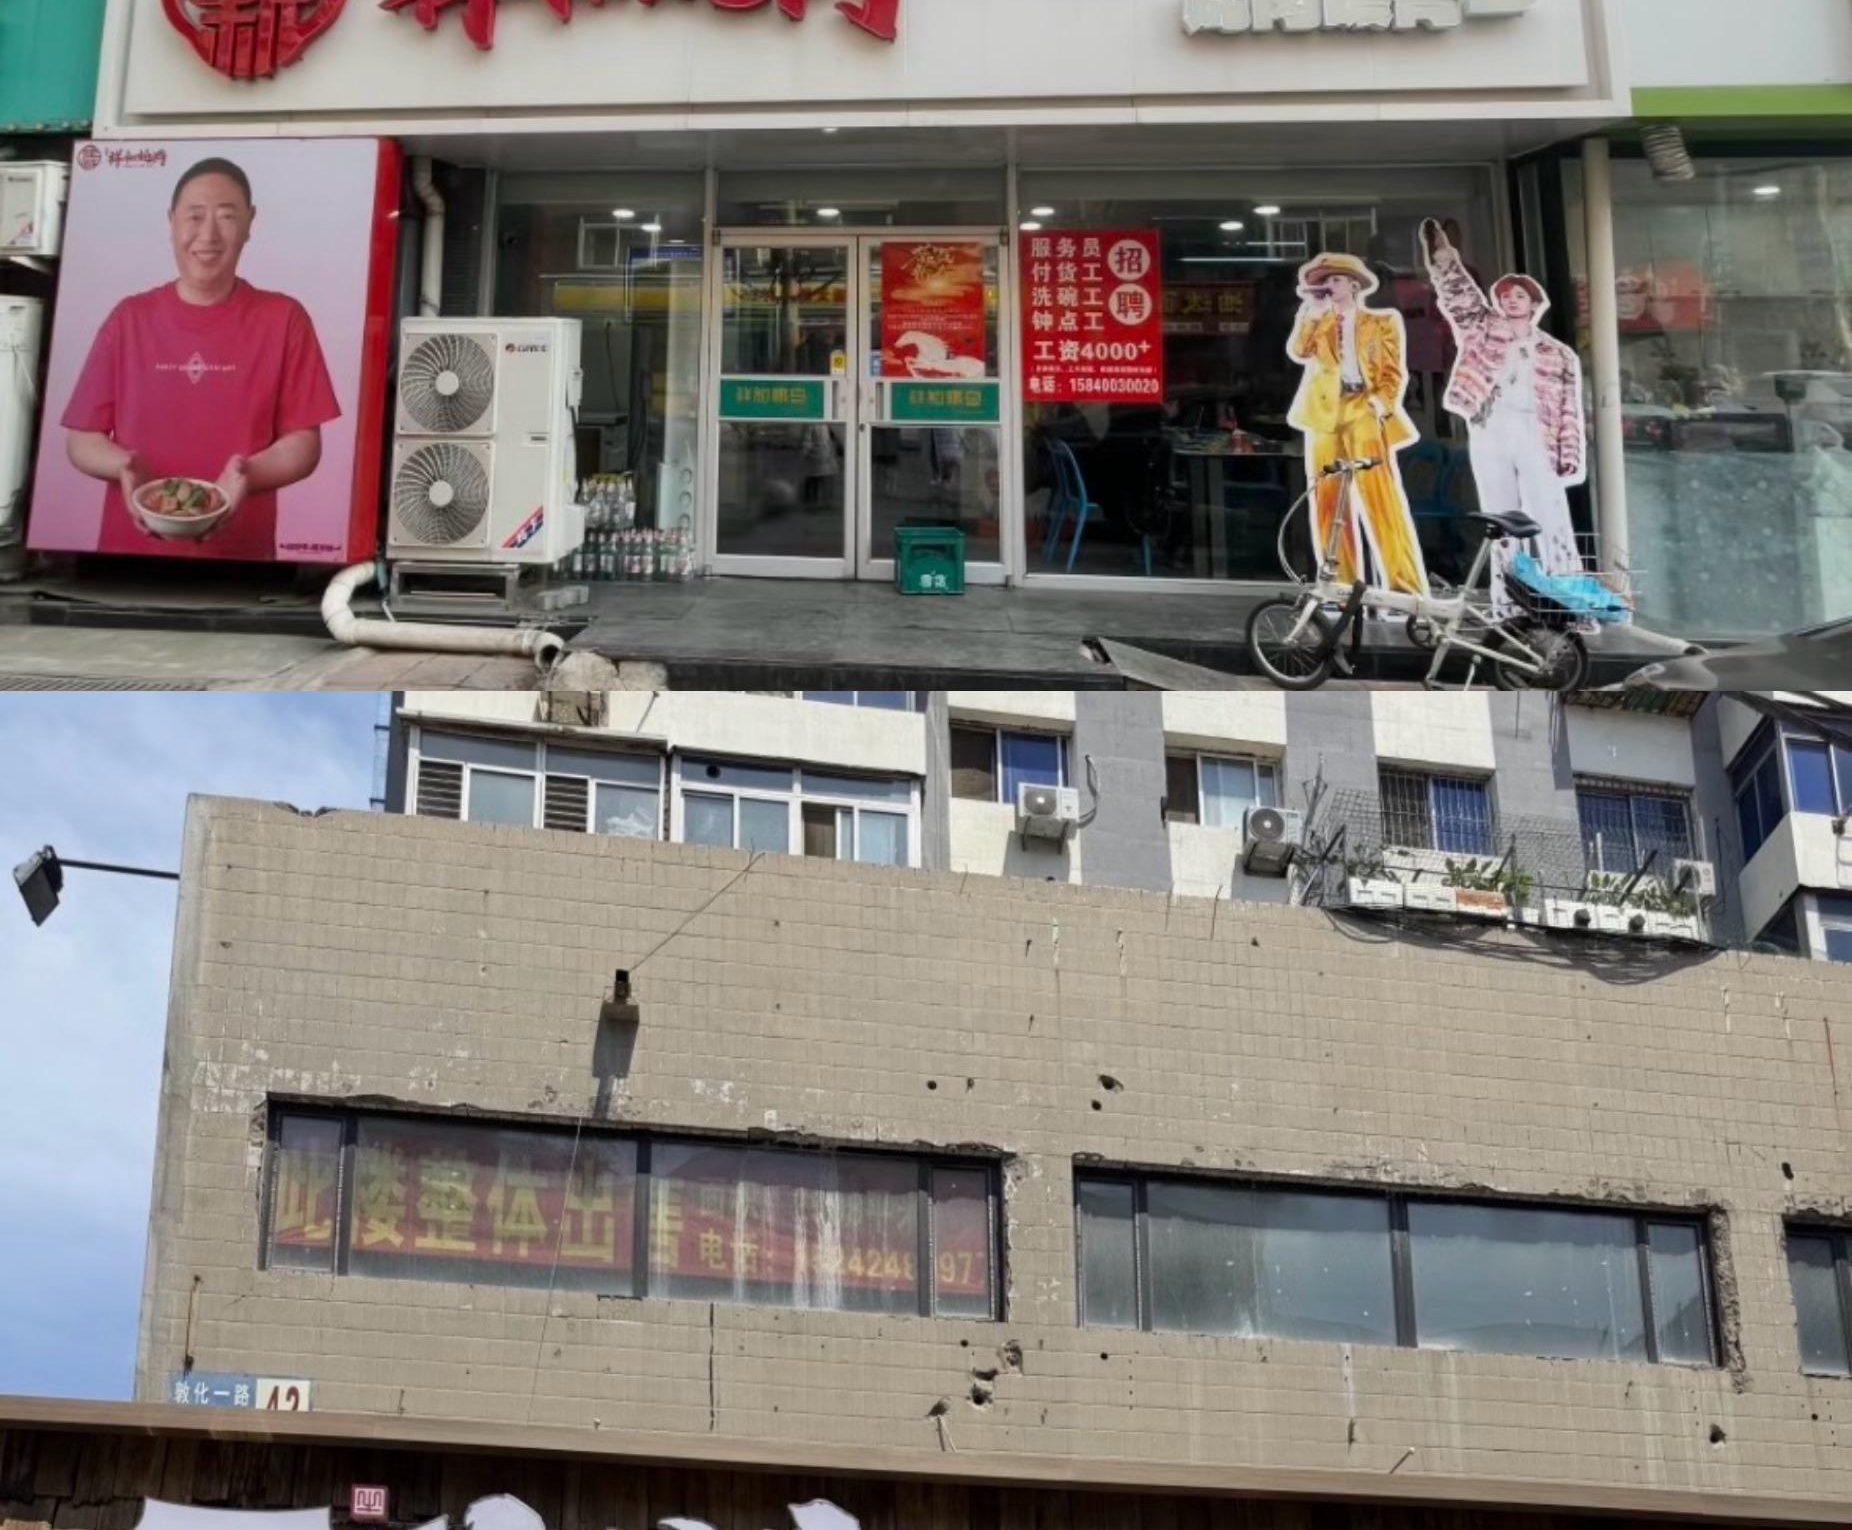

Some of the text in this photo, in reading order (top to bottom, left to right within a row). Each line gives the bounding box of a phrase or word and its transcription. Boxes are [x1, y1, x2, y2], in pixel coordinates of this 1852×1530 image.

[1031, 237, 1101, 258] 服务员
[1031, 262, 1103, 283] 付货工
[1113, 246, 1145, 319] 招聘
[1032, 286, 1104, 307] 洗碗工
[1032, 311, 1105, 331] 钟点工
[174, 1380, 250, 1407] 敦化一路
